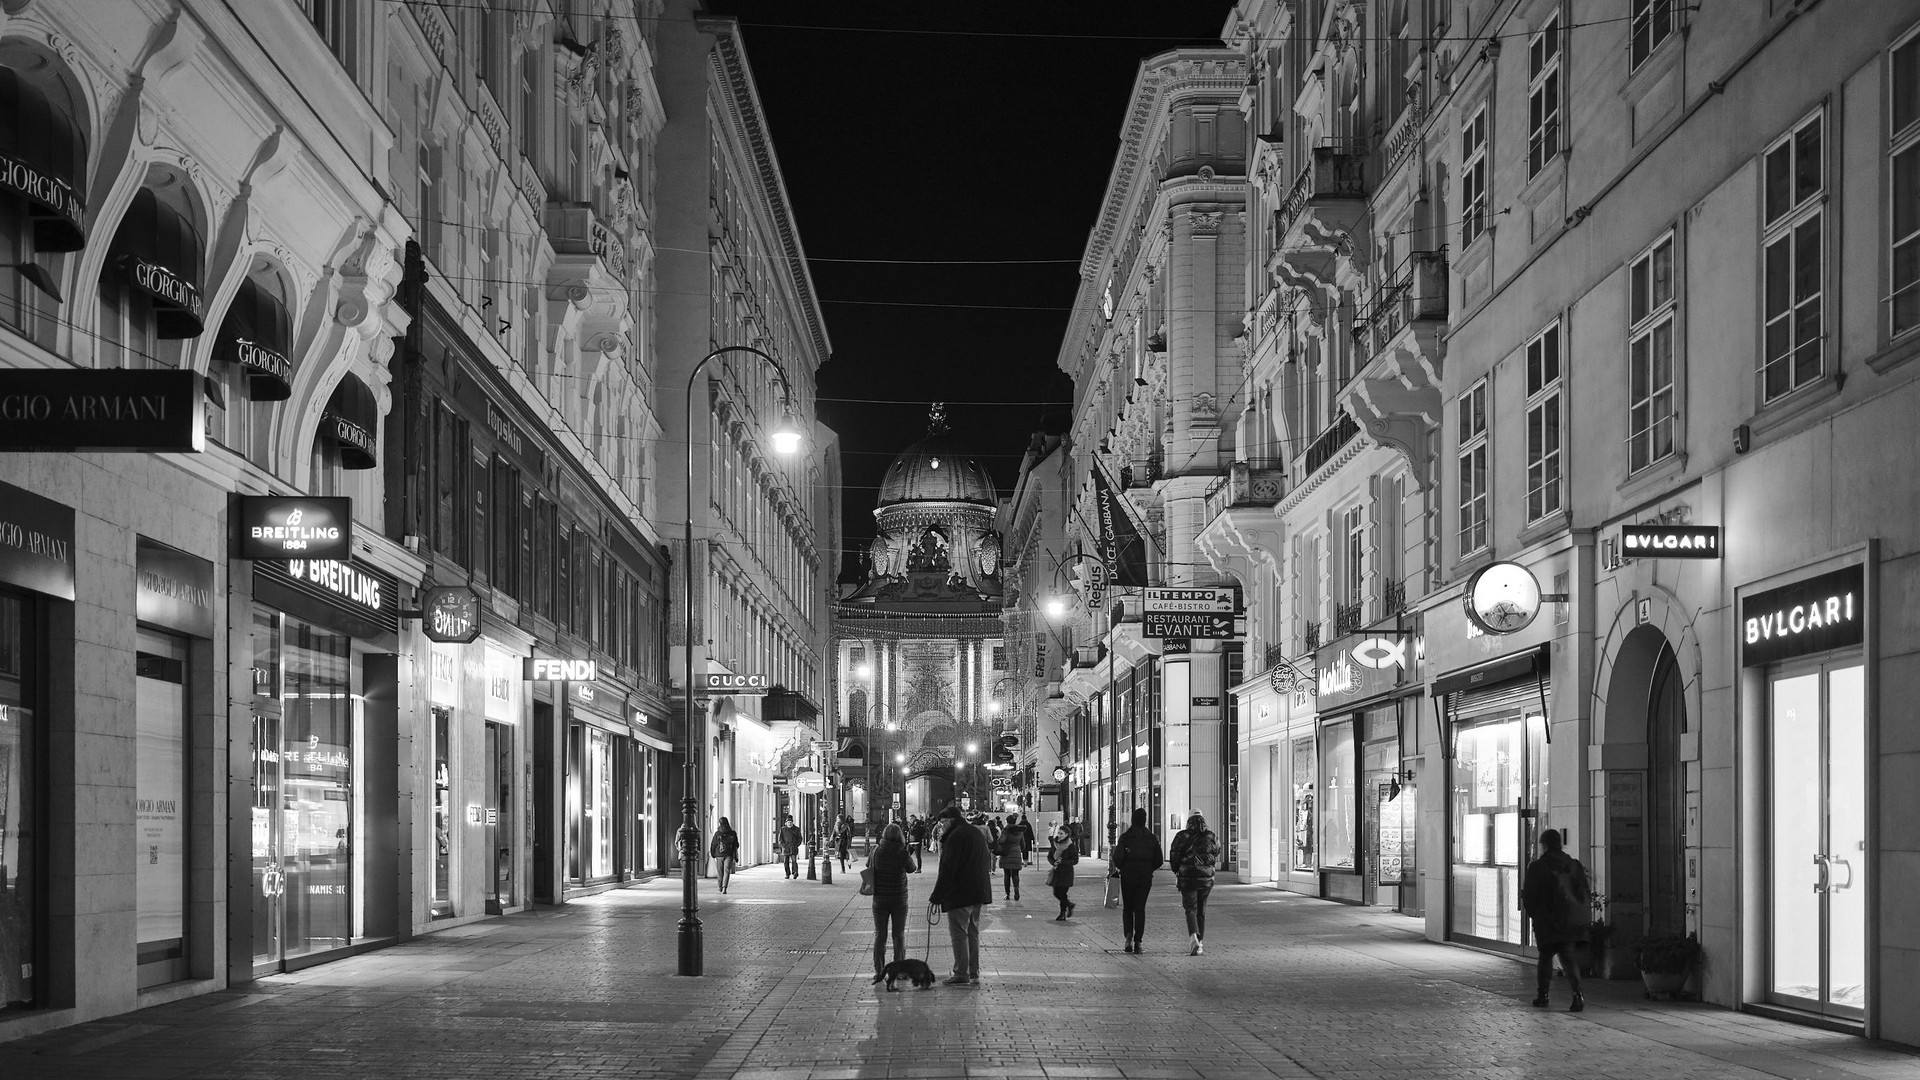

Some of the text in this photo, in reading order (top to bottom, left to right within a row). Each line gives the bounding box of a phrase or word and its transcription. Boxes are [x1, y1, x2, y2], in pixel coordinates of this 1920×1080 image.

[0, 156, 63, 210] GIORGIO
[136, 264, 188, 307] GIORGIO
[238, 343, 283, 377] GIORGIO
[0, 395, 166, 421] GIO ARMANI
[1101, 488, 1116, 541] GABBANA
[26, 531, 68, 563] ARMANI
[252, 526, 339, 539] BREITLING
[283, 541, 307, 550] 1884
[1625, 534, 1715, 549] BVLGARI
[142, 570, 209, 609] GIORGIO ARMANI
[310, 559, 380, 610] BREITLING
[1089, 566, 1107, 609] Regus
[1147, 591, 1214, 600] IL TEMPO
[1147, 614, 1211, 623] RESTAURANT
[1641, 602, 1648, 617] 4
[1746, 592, 1852, 644] BVLGARI
[1147, 624, 1211, 636] LEVANTE
[533, 659, 596, 680] FENDI
[1035, 644, 1047, 678] ERSTE
[1319, 648, 1351, 697] Mohilla
[709, 675, 766, 687] GUCCI
